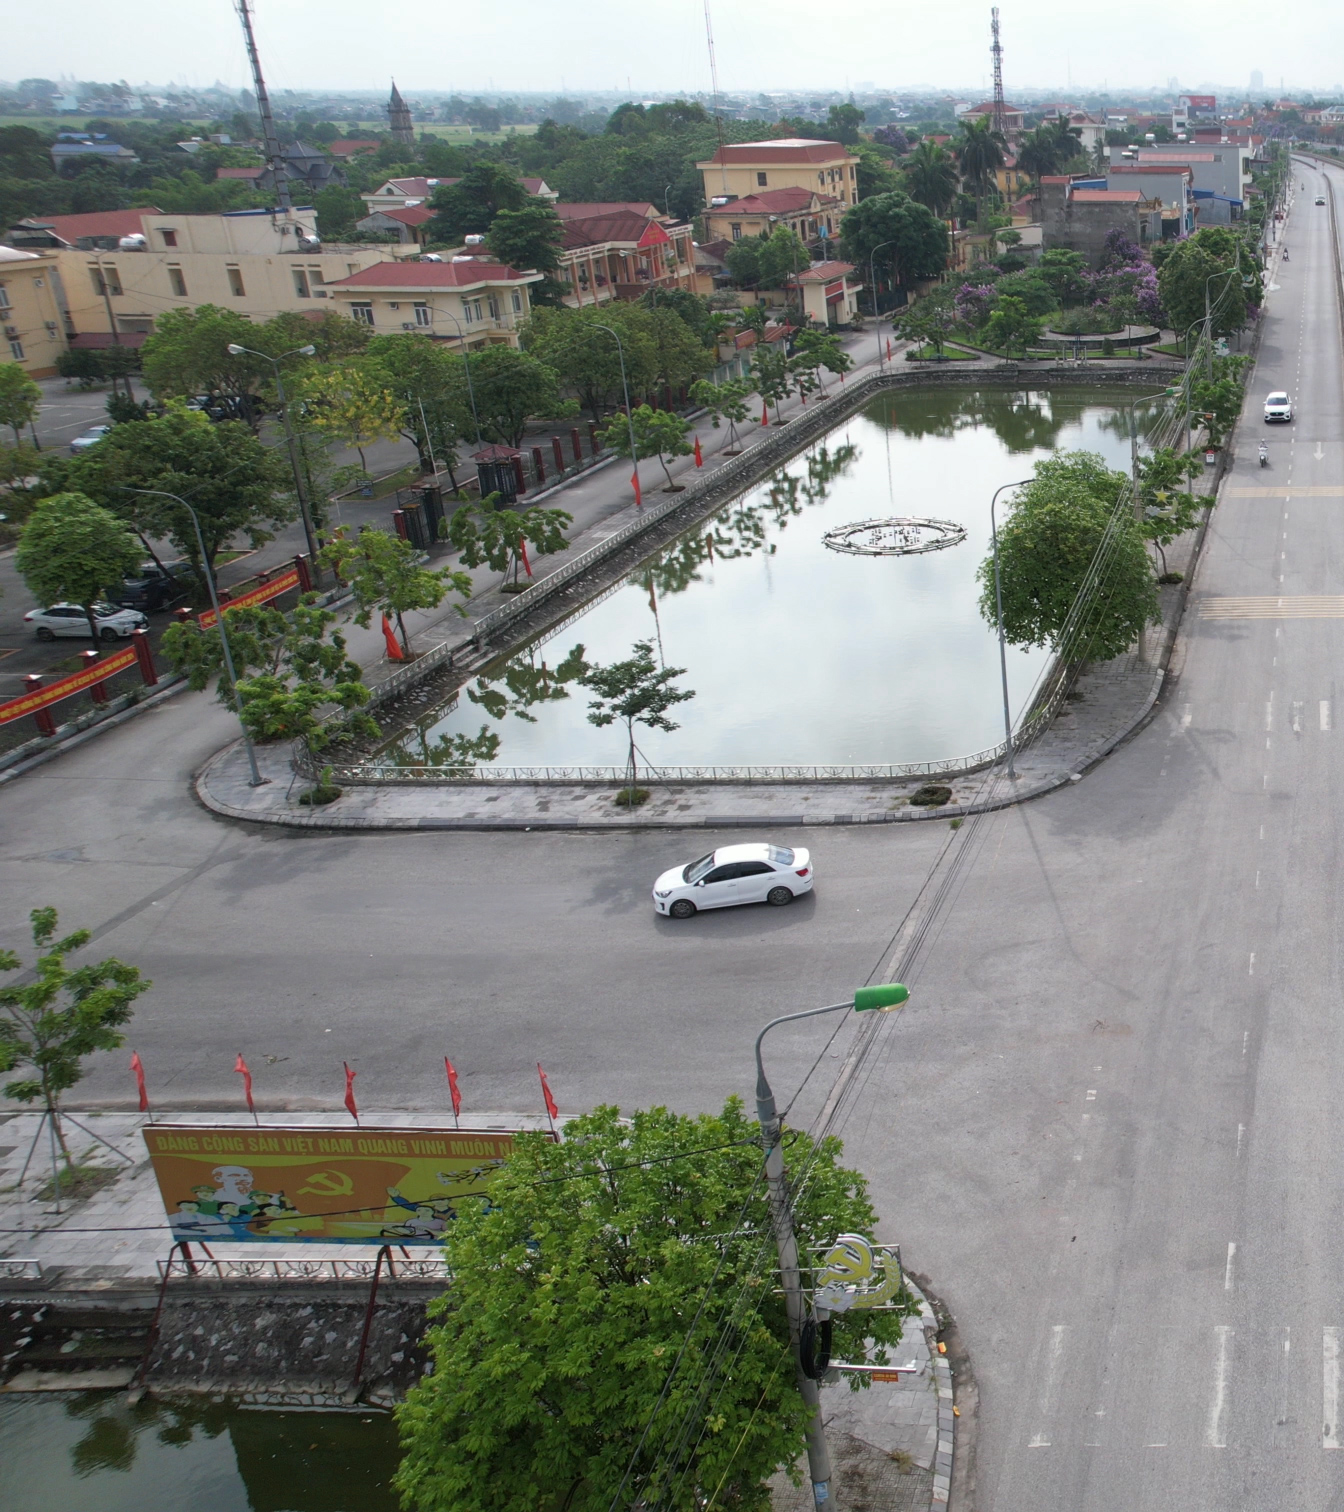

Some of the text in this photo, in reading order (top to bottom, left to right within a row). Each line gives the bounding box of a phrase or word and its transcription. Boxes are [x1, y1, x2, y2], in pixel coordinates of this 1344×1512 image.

[156, 1132, 198, 1151] ĐẢNG
[202, 1134, 243, 1154] CỘNG
[247, 1133, 280, 1152] SẢN
[282, 1135, 314, 1155] VIỆT
[318, 1138, 353, 1152] NAM
[357, 1138, 408, 1155] QUANG
[410, 1140, 447, 1155] VINH
[451, 1138, 495, 1156] MUÔN
